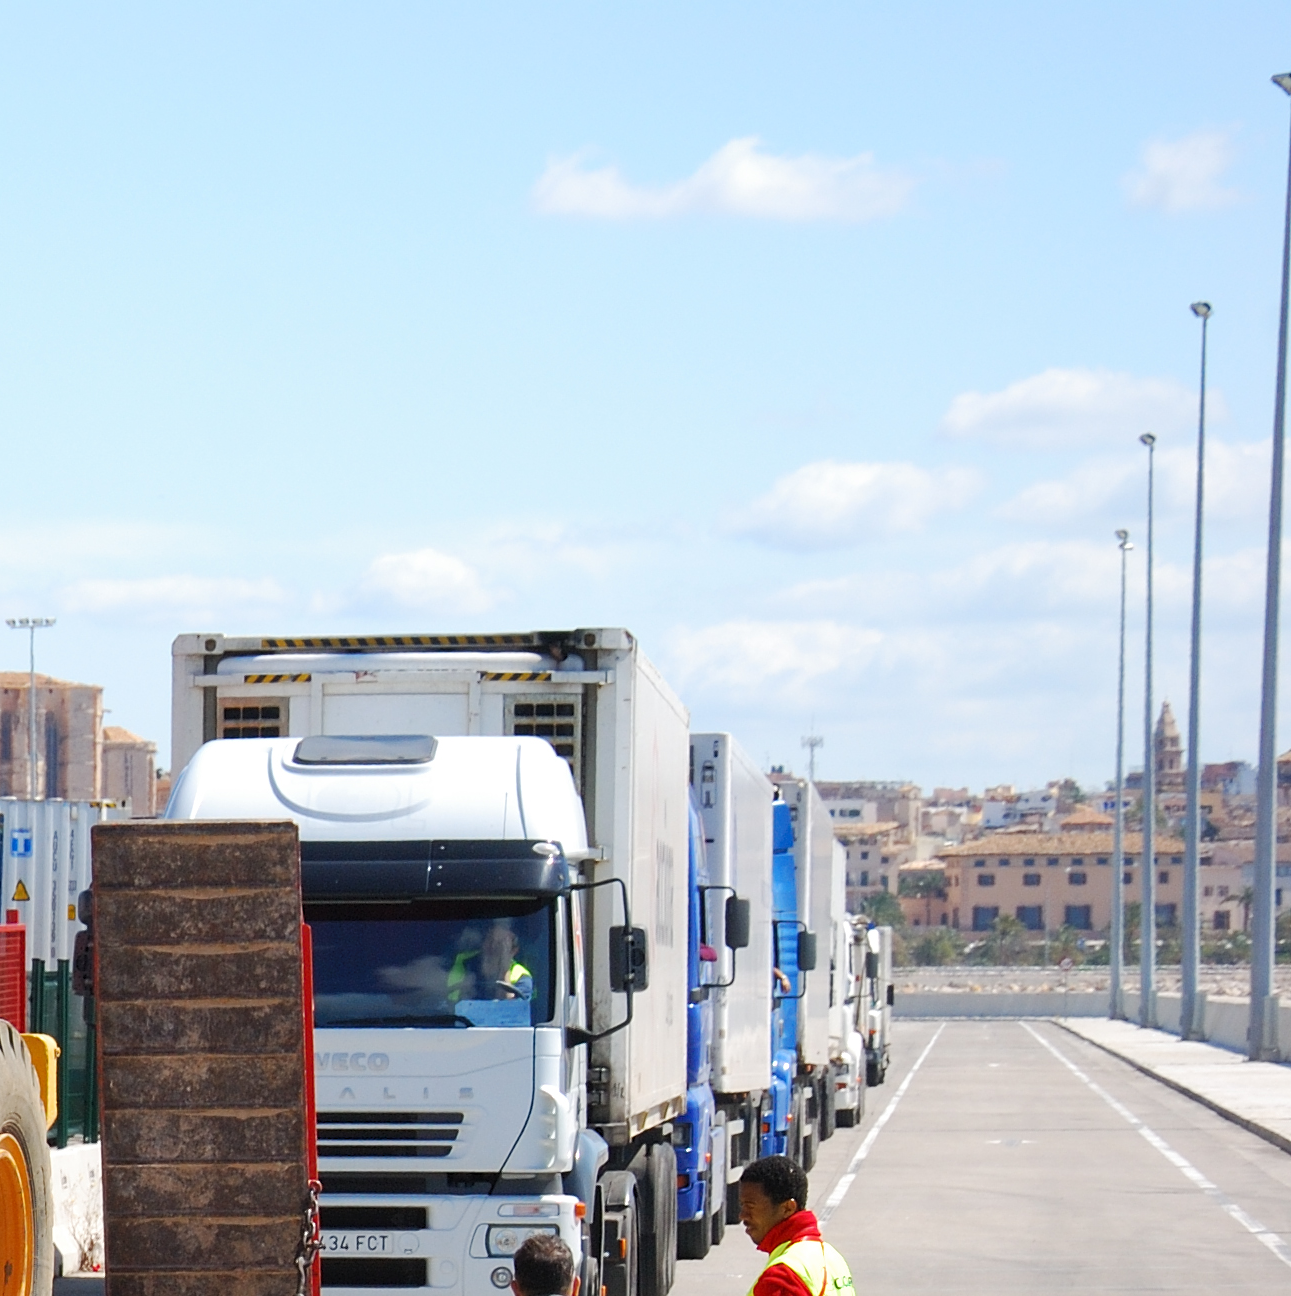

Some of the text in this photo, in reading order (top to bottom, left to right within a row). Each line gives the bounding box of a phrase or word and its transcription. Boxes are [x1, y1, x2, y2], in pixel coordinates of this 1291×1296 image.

[315, 1052, 390, 1072] VECO
[339, 1086, 474, 1100] ALIS
[318, 1235, 389, 1252] 434 FCT
